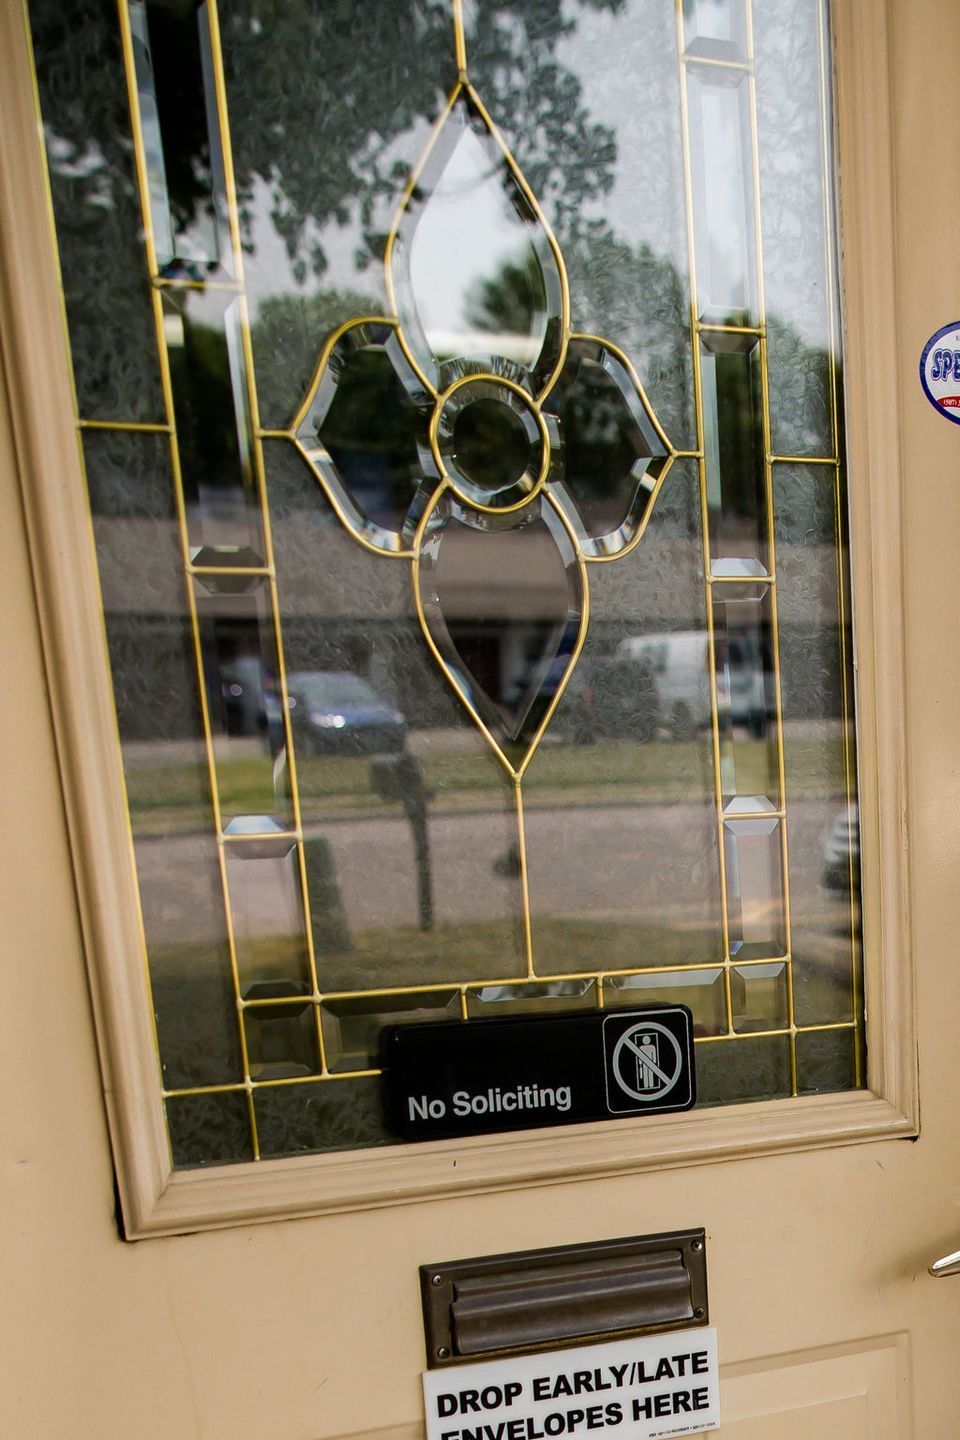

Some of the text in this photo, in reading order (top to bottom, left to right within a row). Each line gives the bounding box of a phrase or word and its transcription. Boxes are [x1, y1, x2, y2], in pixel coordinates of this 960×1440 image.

[408, 1084, 571, 1121] No Soliciting
[437, 1350, 709, 1418] DROP EARLY/LATE
[632, 1387, 710, 1422] HERE
